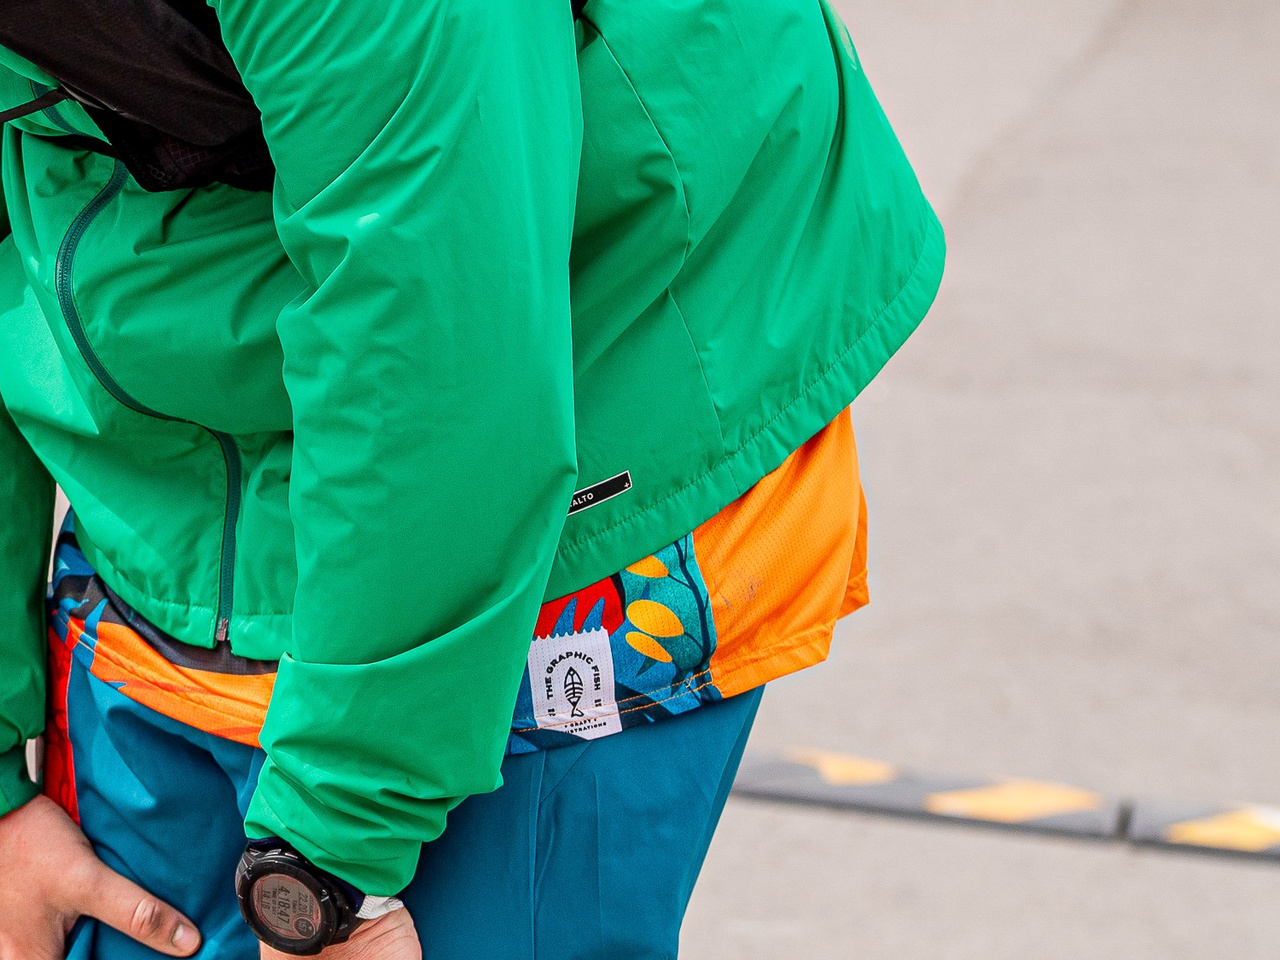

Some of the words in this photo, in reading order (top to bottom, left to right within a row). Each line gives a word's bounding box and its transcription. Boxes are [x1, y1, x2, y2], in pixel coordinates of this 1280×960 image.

[546, 651, 594, 674] GRAPHIC
[544, 676, 554, 700] THE
[591, 665, 601, 691] FISH
